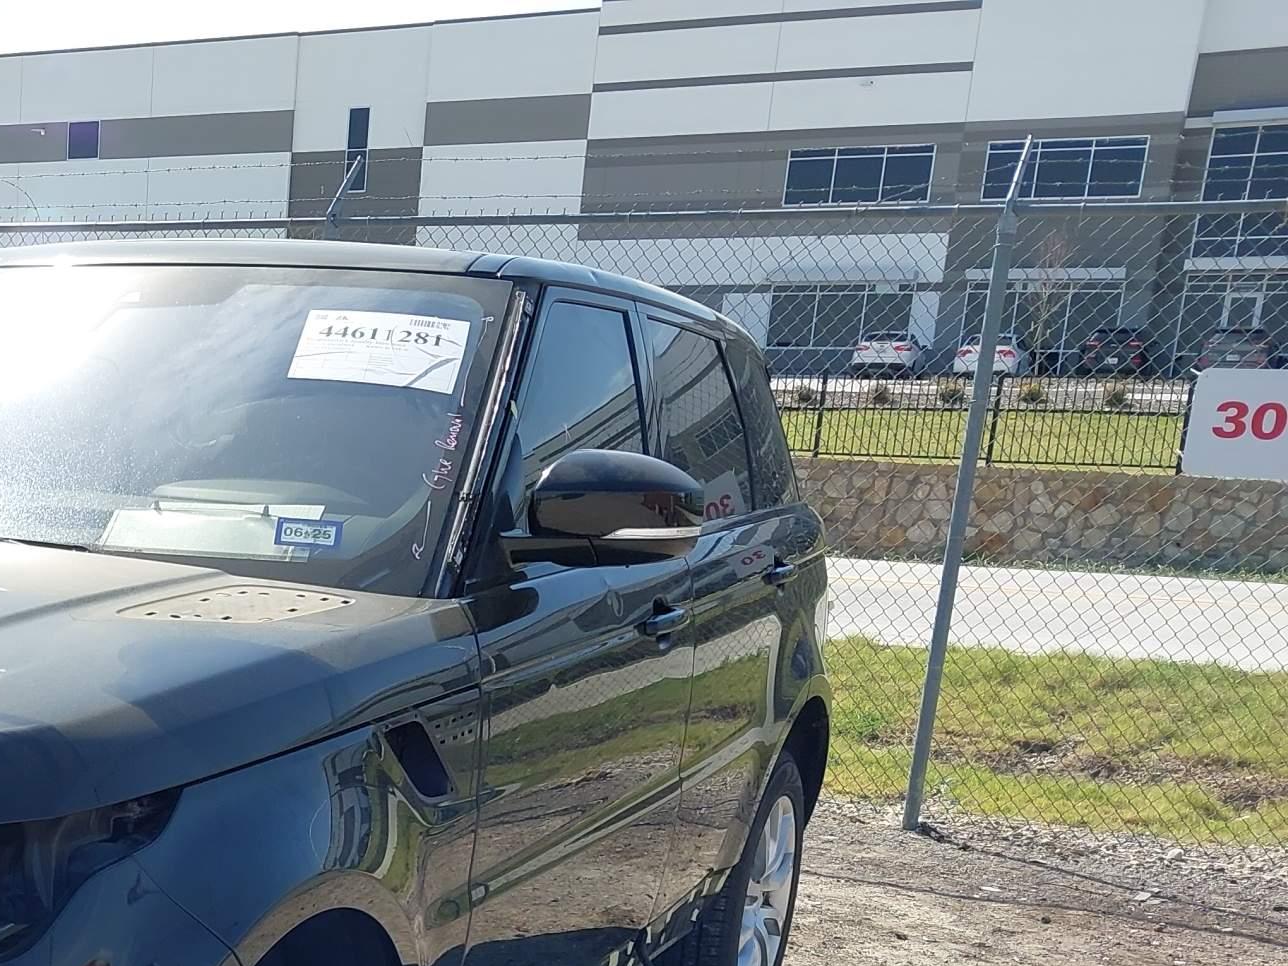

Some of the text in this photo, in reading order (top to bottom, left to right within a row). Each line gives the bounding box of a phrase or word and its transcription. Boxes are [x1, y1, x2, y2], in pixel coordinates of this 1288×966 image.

[318, 325, 442, 347] 44611281
[1212, 400, 1288, 440] 30
[283, 526, 332, 540] 06 25
